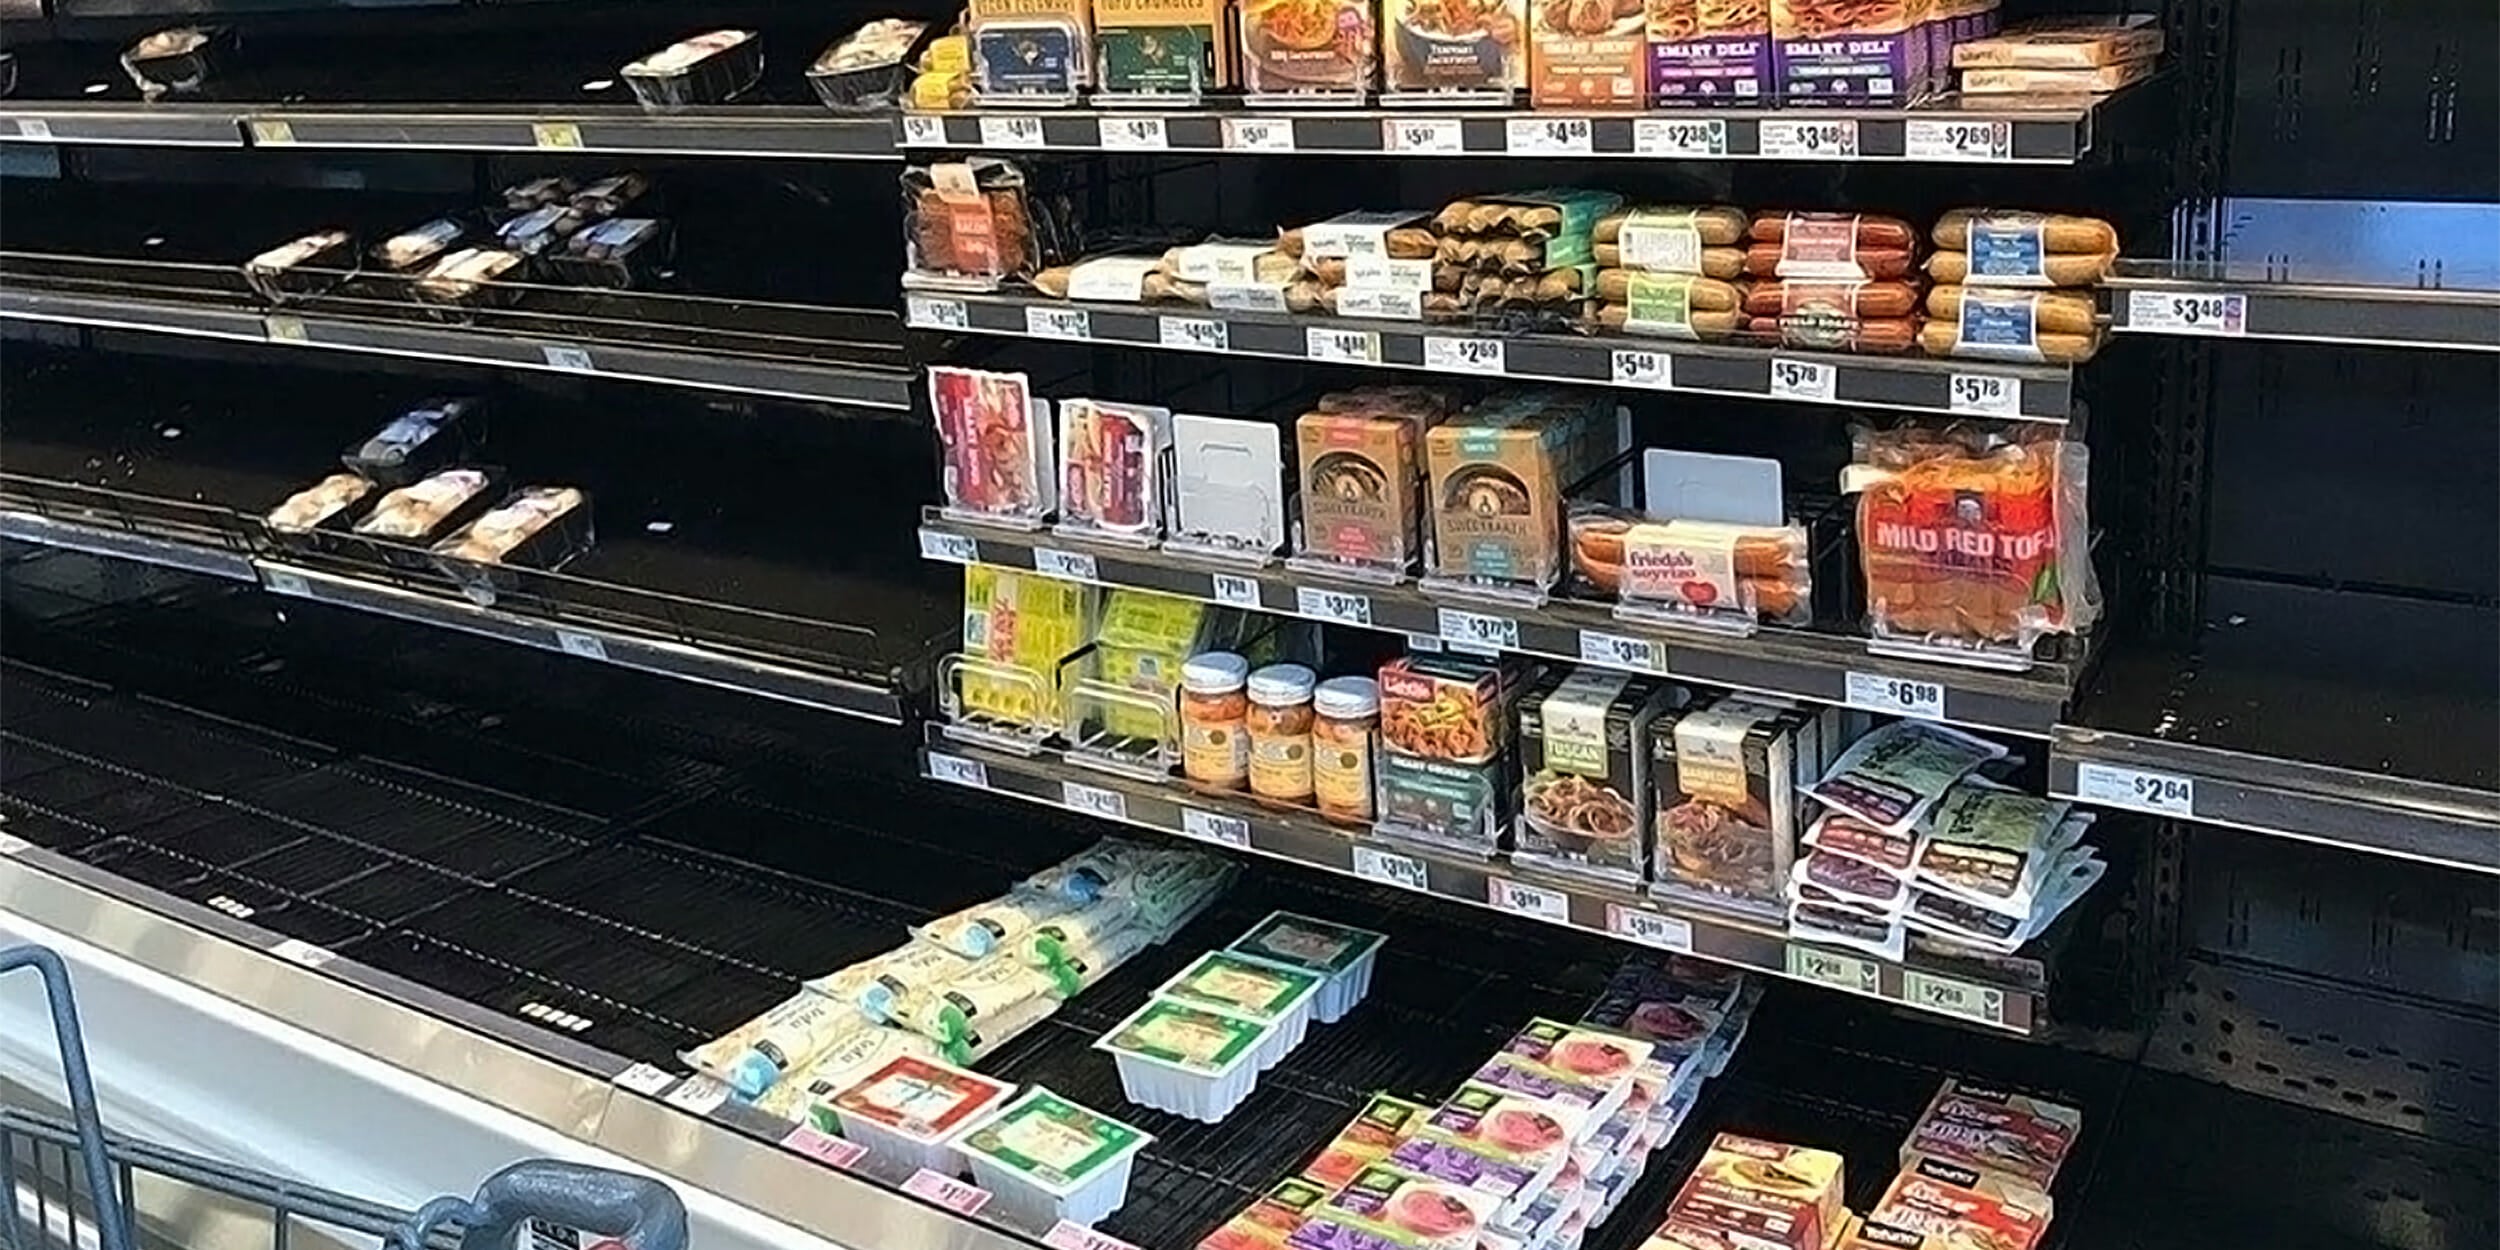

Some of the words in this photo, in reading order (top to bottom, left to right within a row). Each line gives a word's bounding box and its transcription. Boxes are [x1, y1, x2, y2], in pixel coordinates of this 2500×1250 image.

[1657, 44, 1711, 57] SMART
[1715, 43, 1759, 56] DELI
[1785, 43, 1844, 56] SMART
[1849, 41, 1894, 54] DELI
[1546, 121, 1588, 144] $448
[1668, 125, 1708, 148] $238
[1797, 126, 1840, 150] $348
[1946, 127, 1991, 150] $269
[2173, 299, 2223, 323] $348
[1459, 342, 1499, 363] $269
[1616, 354, 1655, 376] $548
[1776, 362, 1819, 386] $578
[1955, 378, 2000, 401] $578
[1876, 520, 1938, 552] MILD
[1944, 526, 1995, 558] RED
[1630, 550, 1694, 567] frieda's
[1632, 568, 1697, 583] soyrizo
[1888, 681, 1938, 706] $698
[2134, 776, 2189, 805] $264
